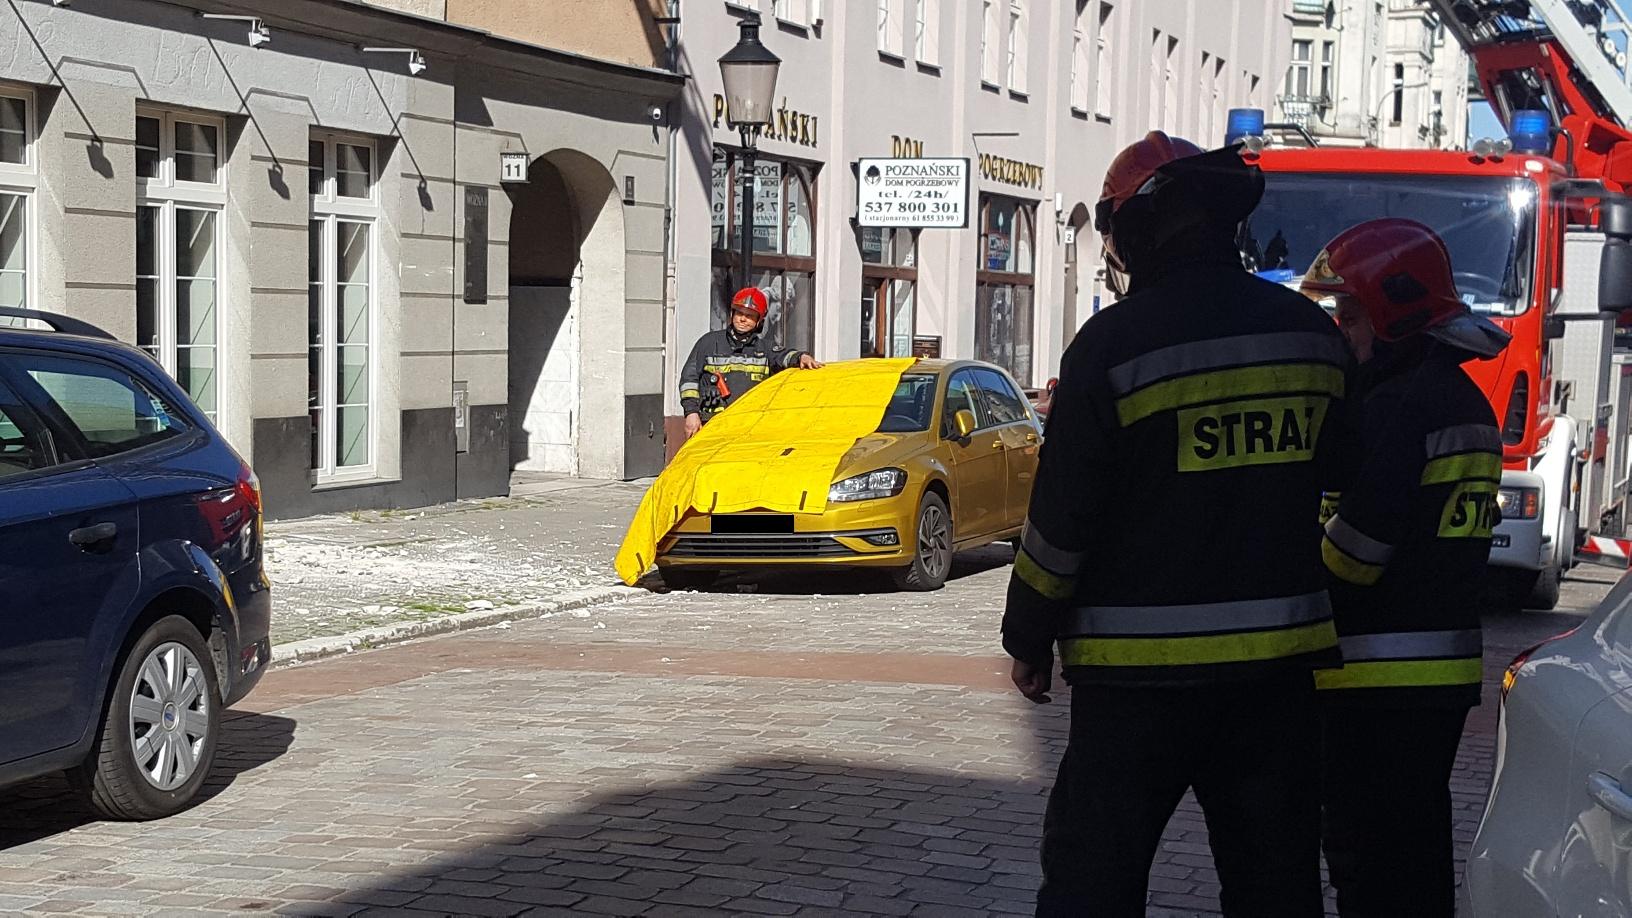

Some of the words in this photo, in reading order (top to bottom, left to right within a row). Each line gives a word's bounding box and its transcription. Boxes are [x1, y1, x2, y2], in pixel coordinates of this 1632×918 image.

[505, 163, 521, 177] 11
[885, 163, 960, 176] POZNAŃSKI
[979, 153, 1045, 191] POGRZEBOWY
[878, 190, 902, 198] tel.
[908, 190, 949, 198] /24h/
[864, 202, 892, 213] 537
[898, 202, 926, 213] 800
[931, 202, 959, 213] 301
